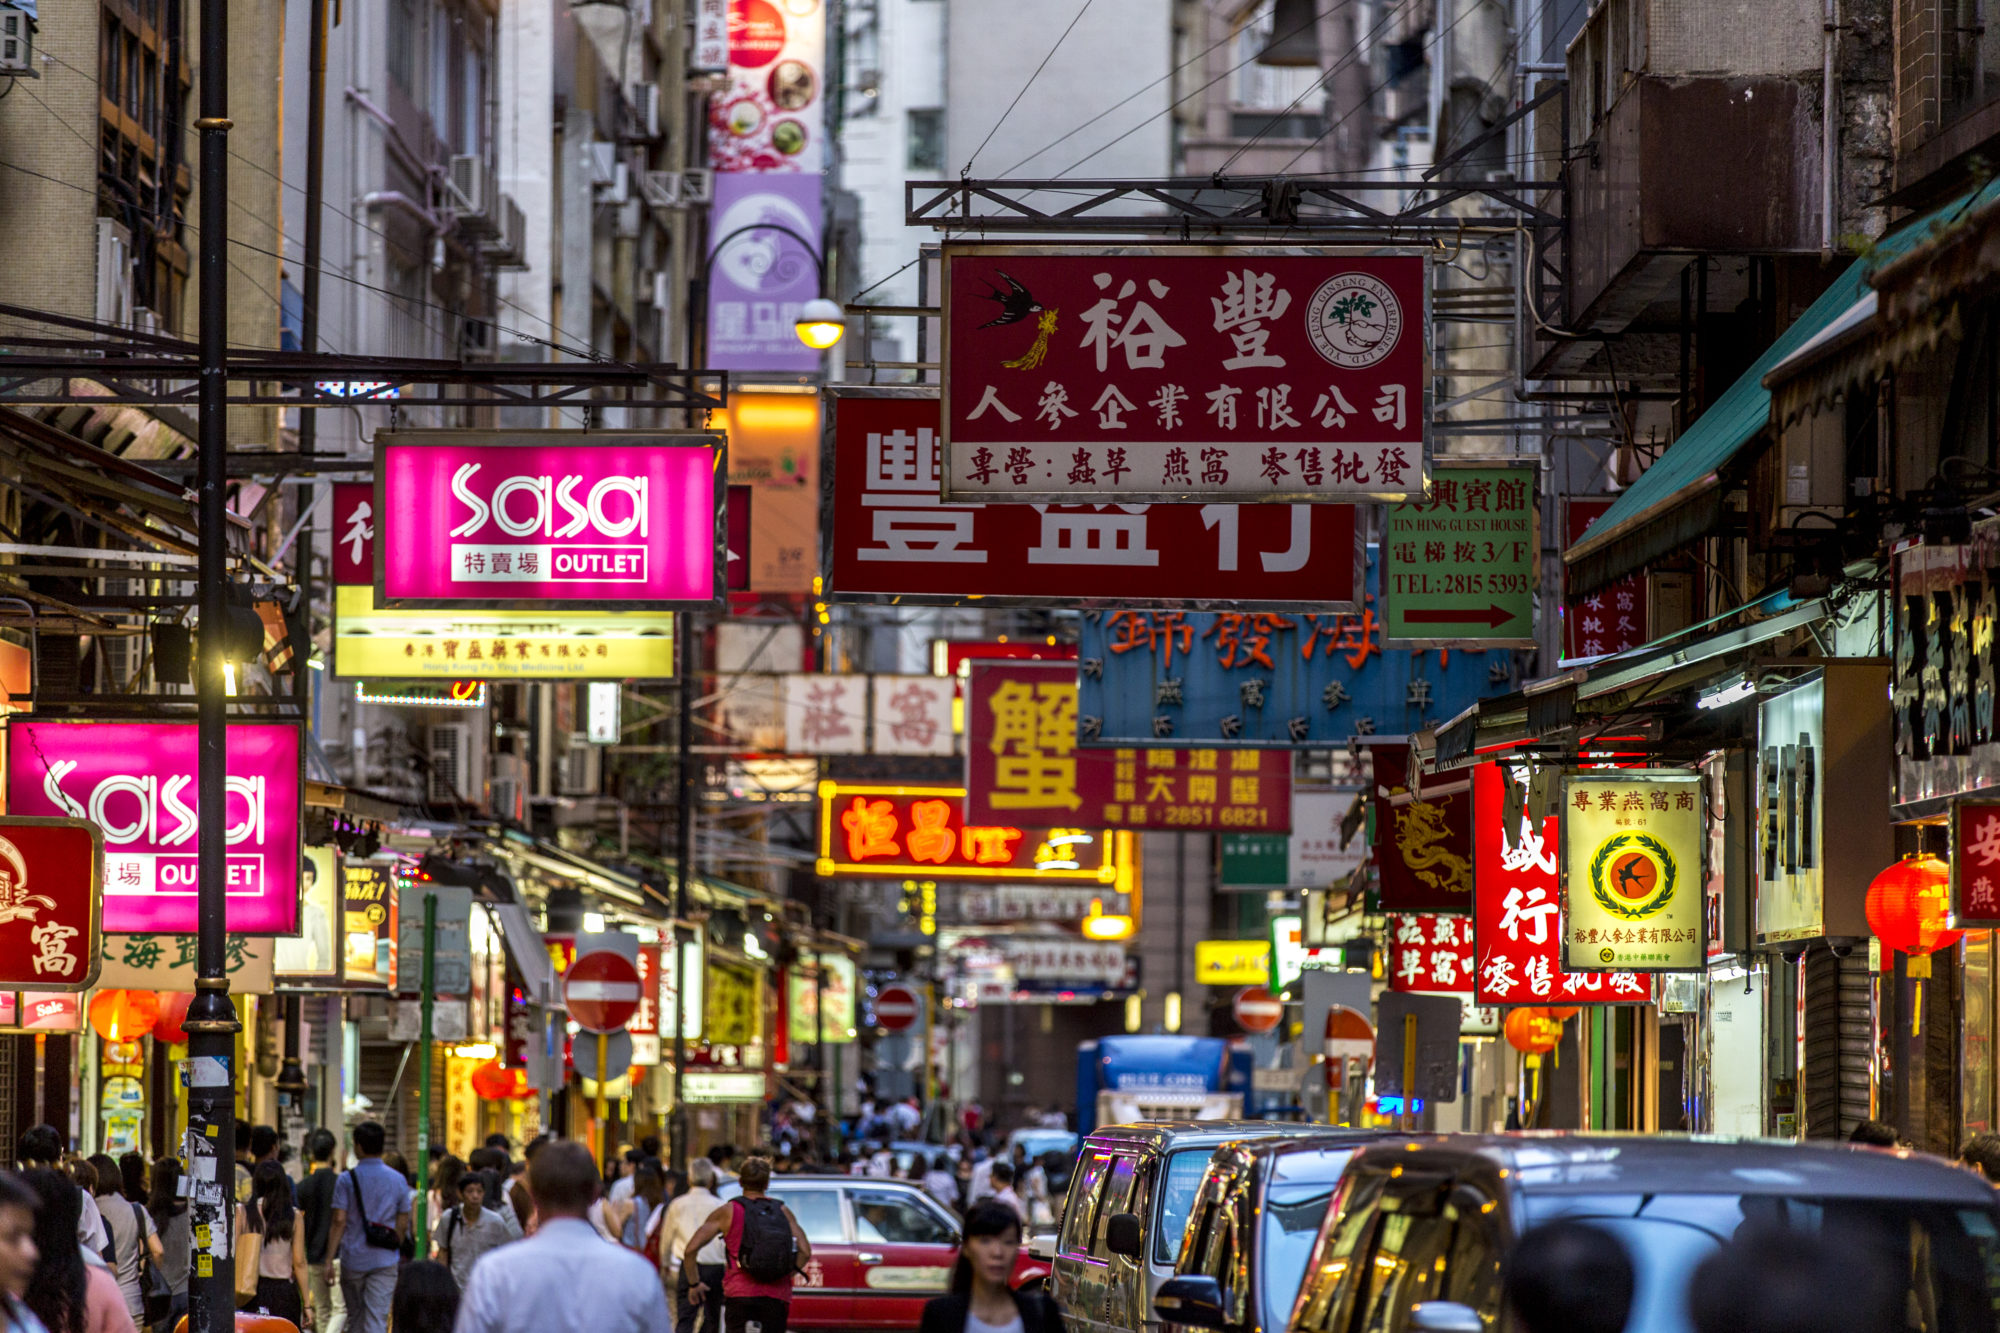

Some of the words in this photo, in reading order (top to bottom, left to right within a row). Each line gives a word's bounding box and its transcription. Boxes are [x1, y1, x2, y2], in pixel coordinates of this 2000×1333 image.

[1318, 278, 1366, 303] GINSENG
[1079, 268, 1292, 373] 裕豐
[1311, 306, 1322, 339] FUNG
[1371, 283, 1397, 353] ENTERPRISES
[1320, 342, 1341, 360] YUE
[966, 381, 1407, 431] 人參企業有限公司
[1393, 519, 1413, 531] TIN
[1417, 519, 1446, 531] HING
[1450, 519, 1487, 531] GUEST
[1490, 519, 1527, 531] HOUSE
[465, 552, 539, 574] 特賣場
[555, 554, 641, 573] OUTLET
[1488, 574, 1528, 594] 5393
[1571, 790, 1696, 812] 專業燕窩商
[160, 864, 256, 885] OUET
[36, 1002, 64, 1017] Sale
